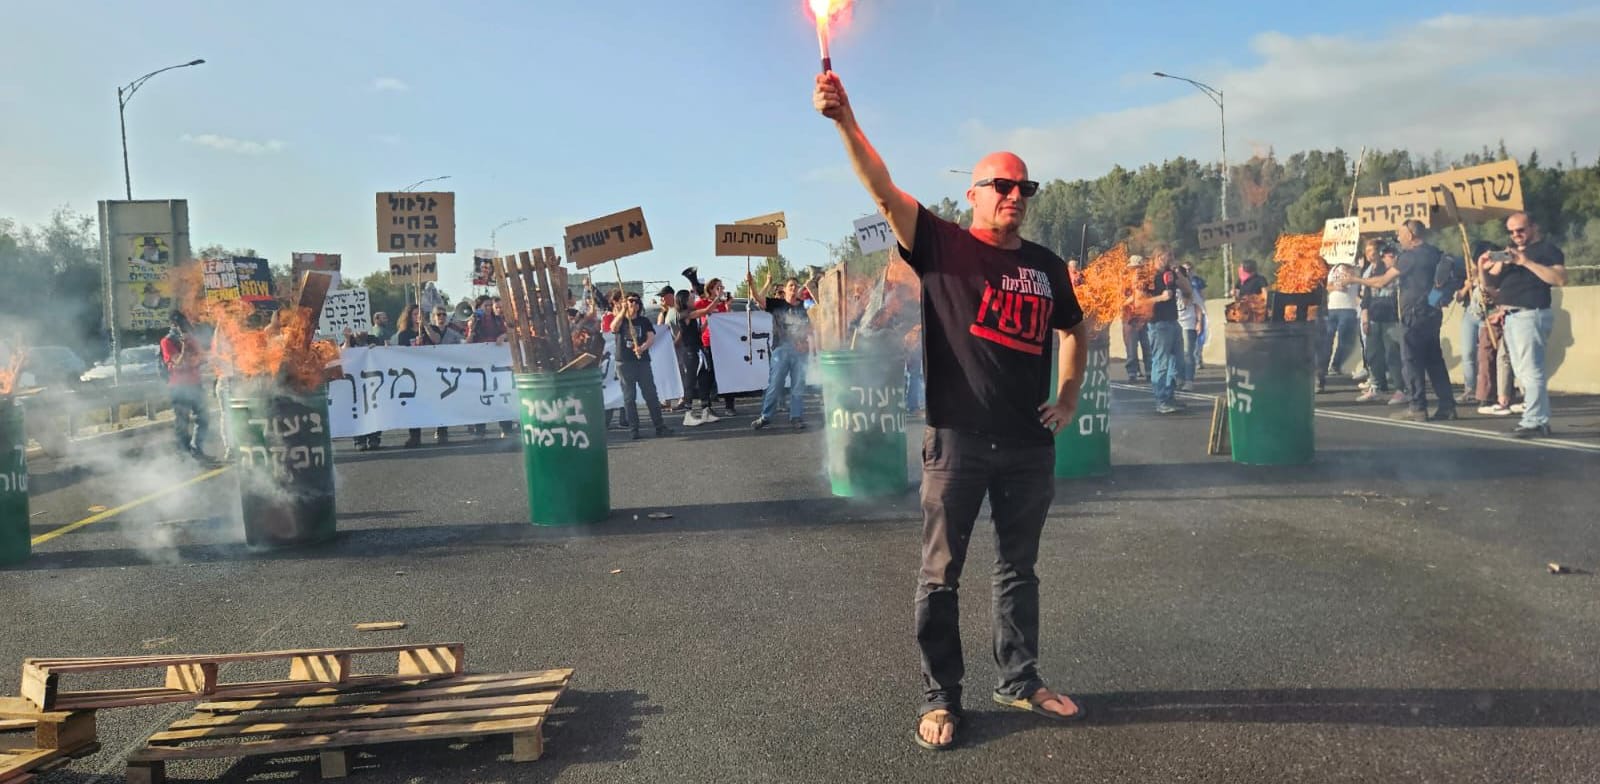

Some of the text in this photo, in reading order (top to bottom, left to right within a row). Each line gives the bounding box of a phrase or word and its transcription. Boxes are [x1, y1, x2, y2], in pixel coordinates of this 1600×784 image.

[1395, 172, 1514, 213] שחית
[392, 215, 439, 230] בחיי
[1362, 202, 1427, 224] הפקרה
[722, 231, 776, 245] שחיתות
[858, 221, 893, 243] קרה
[1202, 220, 1258, 241] הפקרה
[391, 233, 437, 249] אדם
[240, 279, 269, 297] NOW
[1002, 274, 1032, 294] הביתה
[326, 289, 366, 304] כל ישרא
[325, 303, 366, 319] ערבים
[353, 318, 367, 329] זה
[248, 412, 324, 437] ביעור
[831, 408, 907, 433] שחיתות
[523, 424, 590, 449] מרמה
[239, 445, 325, 480] הפקרה
